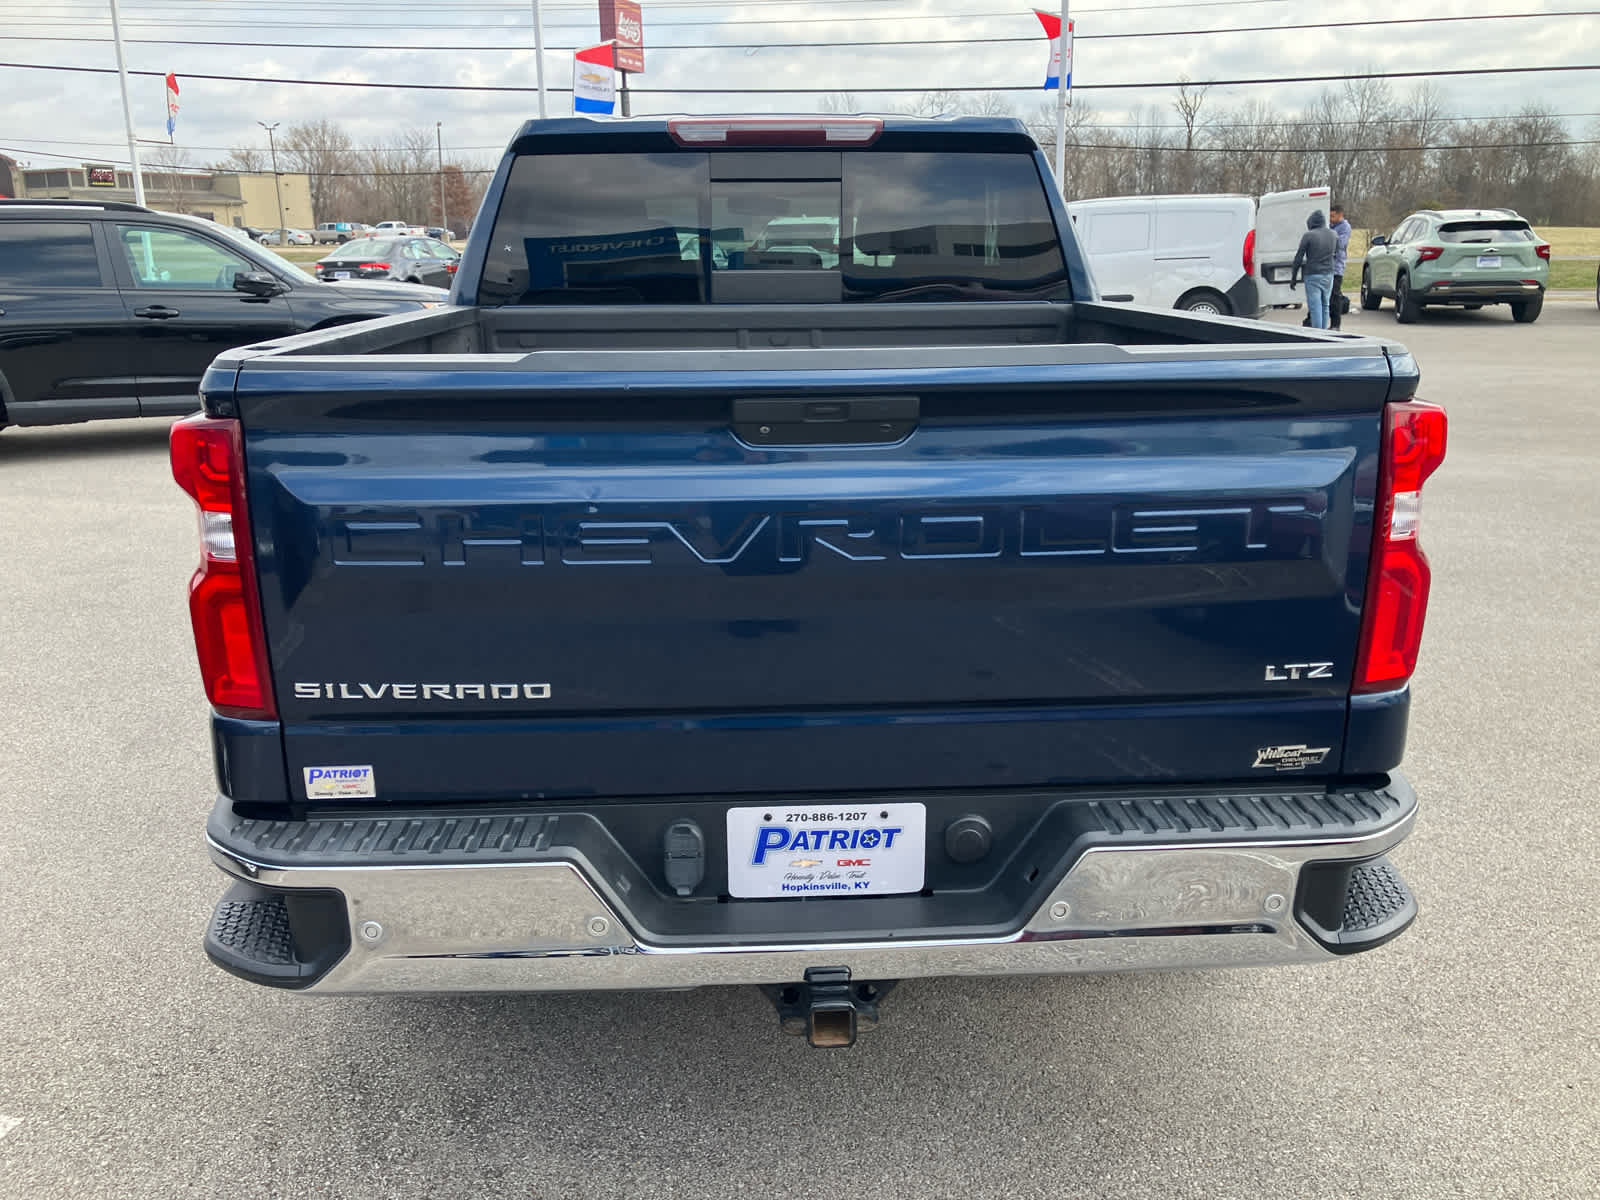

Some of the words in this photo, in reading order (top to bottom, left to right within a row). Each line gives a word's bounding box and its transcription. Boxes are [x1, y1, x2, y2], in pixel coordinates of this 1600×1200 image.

[333, 502, 1307, 567] CHEVROLET
[1264, 662, 1334, 681] LTZ
[294, 682, 552, 700] SILVERADO
[308, 768, 370, 785] PATRIOT
[785, 812, 868, 823] 270-886-1207
[750, 826, 903, 866] PATRIOT
[837, 858, 871, 867] GMC
[781, 882, 851, 893] Hopkinsville,
[854, 881, 870, 889] KY
